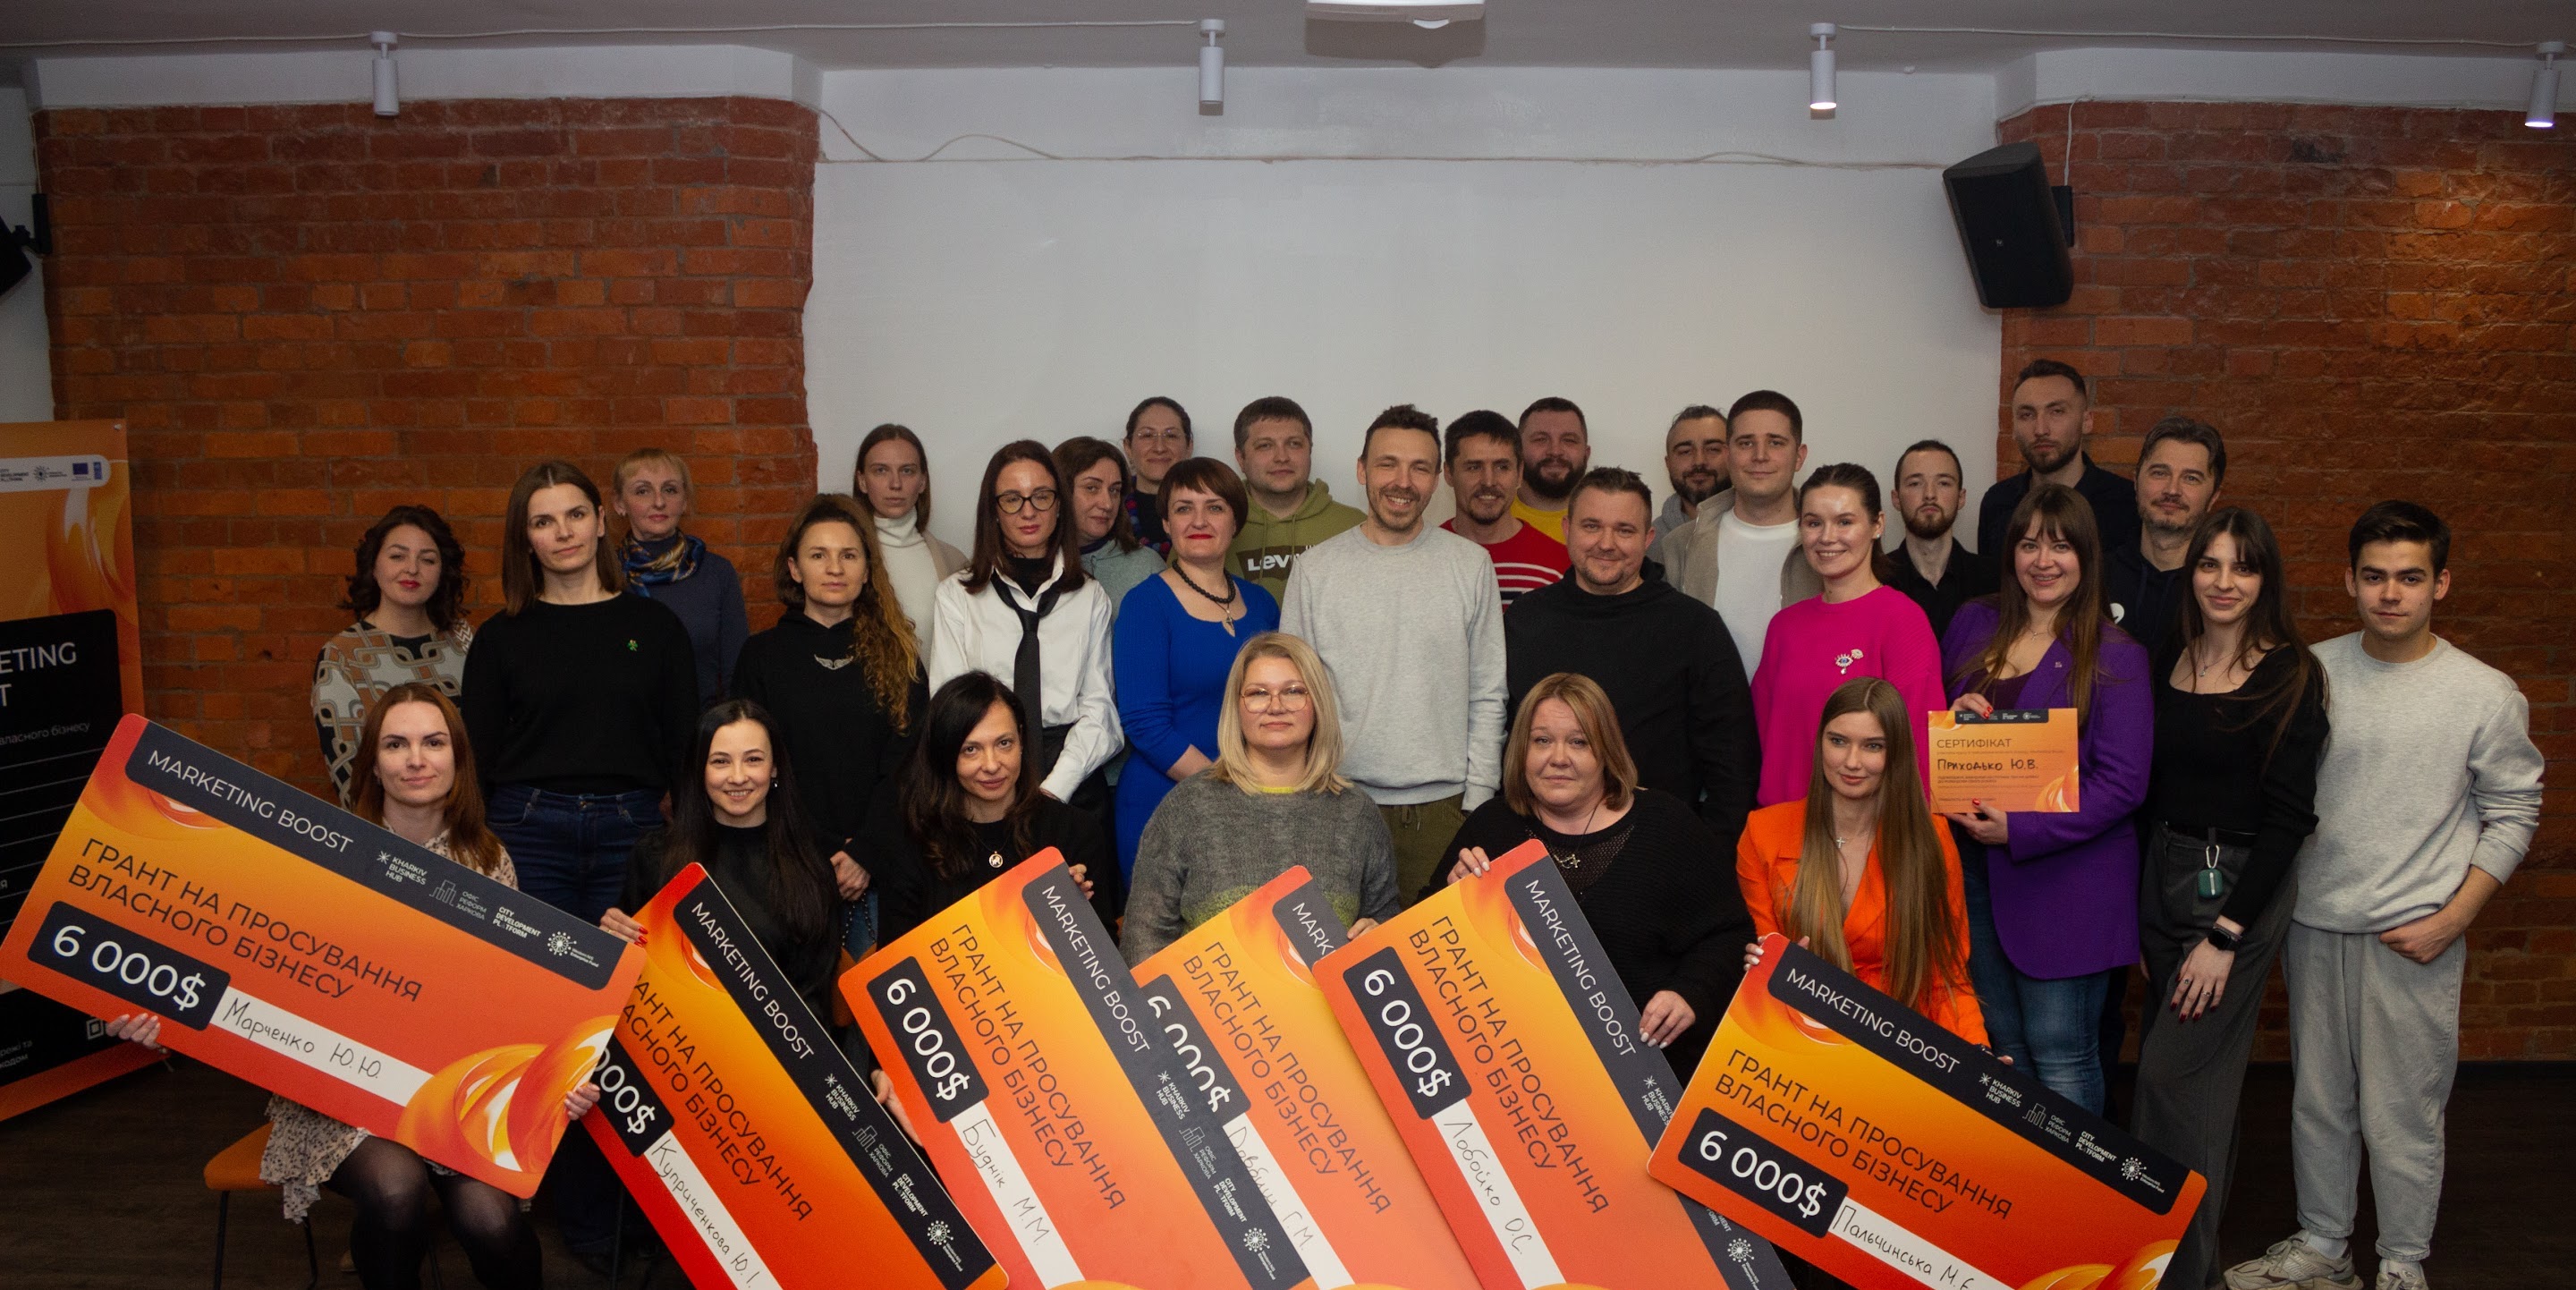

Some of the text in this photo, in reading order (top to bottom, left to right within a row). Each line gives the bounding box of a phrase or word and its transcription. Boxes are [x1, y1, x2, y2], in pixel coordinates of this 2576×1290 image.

[1936, 738, 2012, 749] СЕРТИФІКАТ
[148, 751, 354, 853] MARKETING BOOST
[386, 870, 402, 882] HUB
[388, 863, 427, 885] BUSINESS
[392, 857, 427, 877] KHARKIV
[68, 864, 353, 998] ВЛАСНОГО БІЗНЕСУ
[82, 838, 422, 1002] ГРАНТ НА ПРОСУВАННЯ
[496, 912, 540, 937] DEVELOPMENT
[498, 906, 513, 917] CITY
[691, 902, 815, 1059] MARKETING BOOST
[1042, 886, 1150, 1053] MARKETING BOOST
[1525, 879, 1636, 1056] MARKETING BOOST
[222, 997, 315, 1054] Марченко
[1786, 968, 1961, 1074] MARKETING BOOST
[929, 938, 1073, 1167] ВЛАСНОГО БІЗНЕСУ
[952, 924, 1126, 1210] ГРАНТ НА ПРОСУВАННЯ
[1182, 955, 1338, 1175] ВЛАСНОГО БІЗНЕСУ
[1409, 929, 1557, 1168] ВЛАСНОГО БІЗНЕСУ
[1432, 916, 1609, 1214] ГРАНТ НА ПРОСУВАННЯ
[623, 1006, 760, 1185] АСНОГО БІЗНЕСУ
[634, 974, 813, 1221] АНТ НА ПРОСУВАННЯ
[1156, 1090, 1168, 1105] HUB
[1168, 1082, 1190, 1113] KHARKIV
[1205, 941, 1392, 1215] ГРАНТ НА ПРОСУВАННЯ
[1986, 1092, 2000, 1104] HUB
[1988, 1086, 2021, 1108] BUSINESS
[1992, 1080, 2021, 1099] KHARKIV
[826, 1093, 838, 1109] HUB
[830, 1089, 856, 1121] BUSINESS
[835, 1084, 860, 1114] KHARKIV
[1162, 1085, 1185, 1119] BUSINESS
[1640, 1094, 1653, 1111] HUB
[1715, 1074, 1954, 1214] ВЛАСНОГО БІЗНЕСУ
[1727, 1049, 2012, 1220] ГРАНТ НА ПРОСУВАННЯ
[2078, 1137, 2116, 1161] DEVELOPMENT
[2081, 1132, 2094, 1141] CITY
[902, 1173, 913, 1188] CITY
[1224, 1177, 1235, 1192] CITY
[1443, 1122, 1501, 1207] Лобойко
[650, 1139, 730, 1255] Куприченкова
[896, 1177, 928, 1217] DEVELOPMENT
[1218, 1181, 1247, 1222] DEVELOPMENT
[1832, 1205, 1932, 1276] Пальчинська
